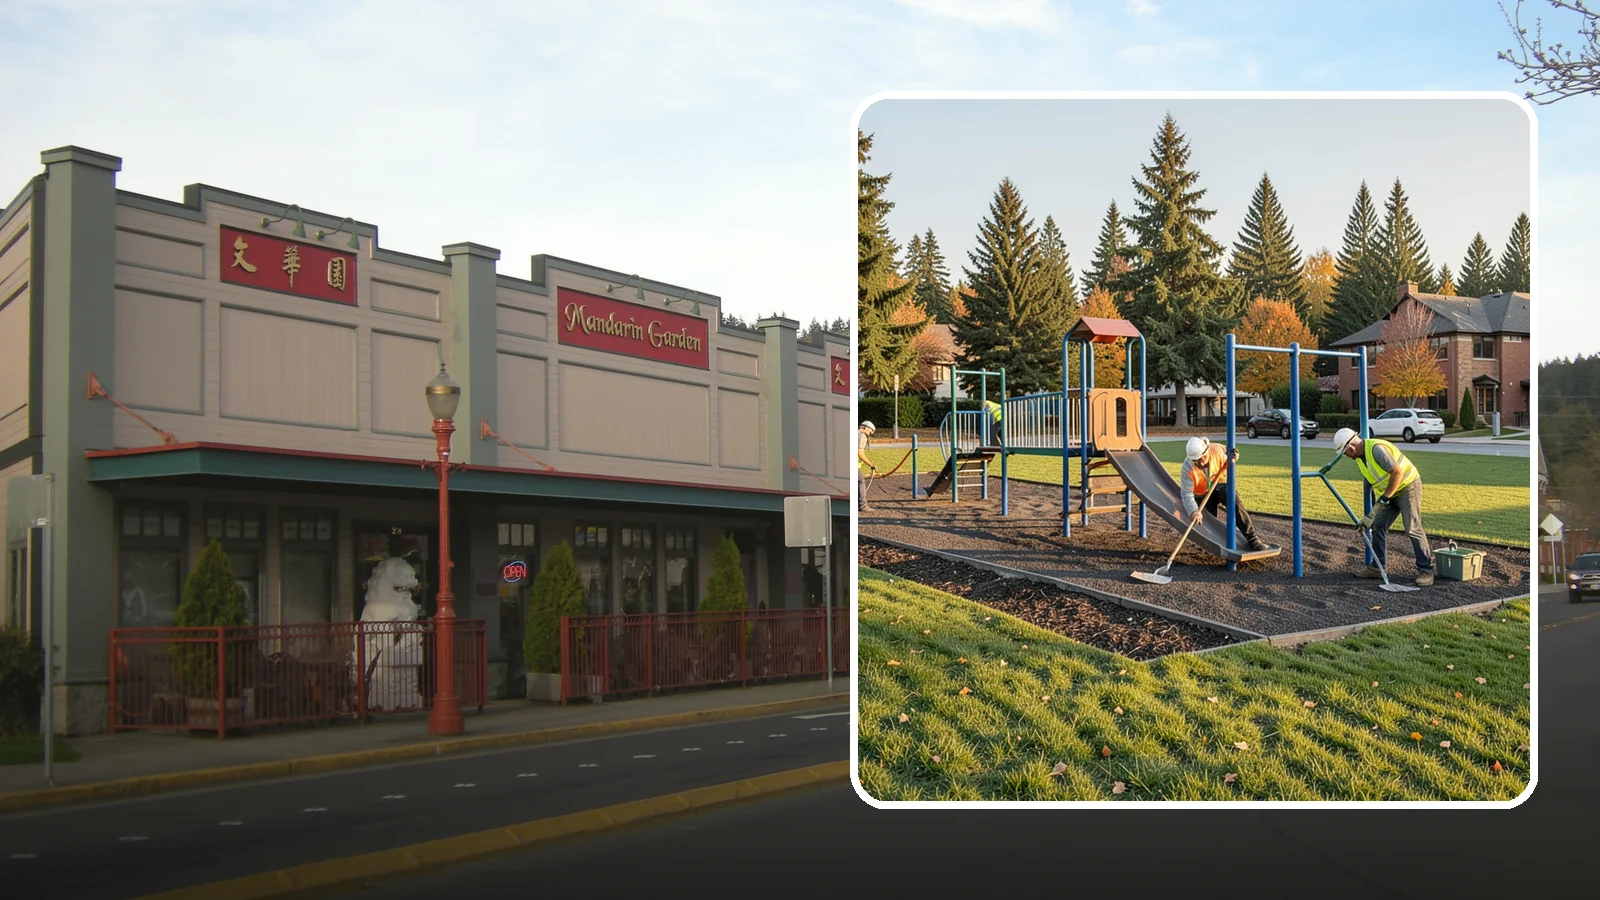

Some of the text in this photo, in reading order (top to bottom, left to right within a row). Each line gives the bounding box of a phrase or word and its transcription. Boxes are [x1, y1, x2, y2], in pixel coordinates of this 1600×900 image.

[230, 235, 346, 291] 文華園
[564, 302, 702, 352] Mandarin Garden
[503, 565, 527, 578] OPEN
